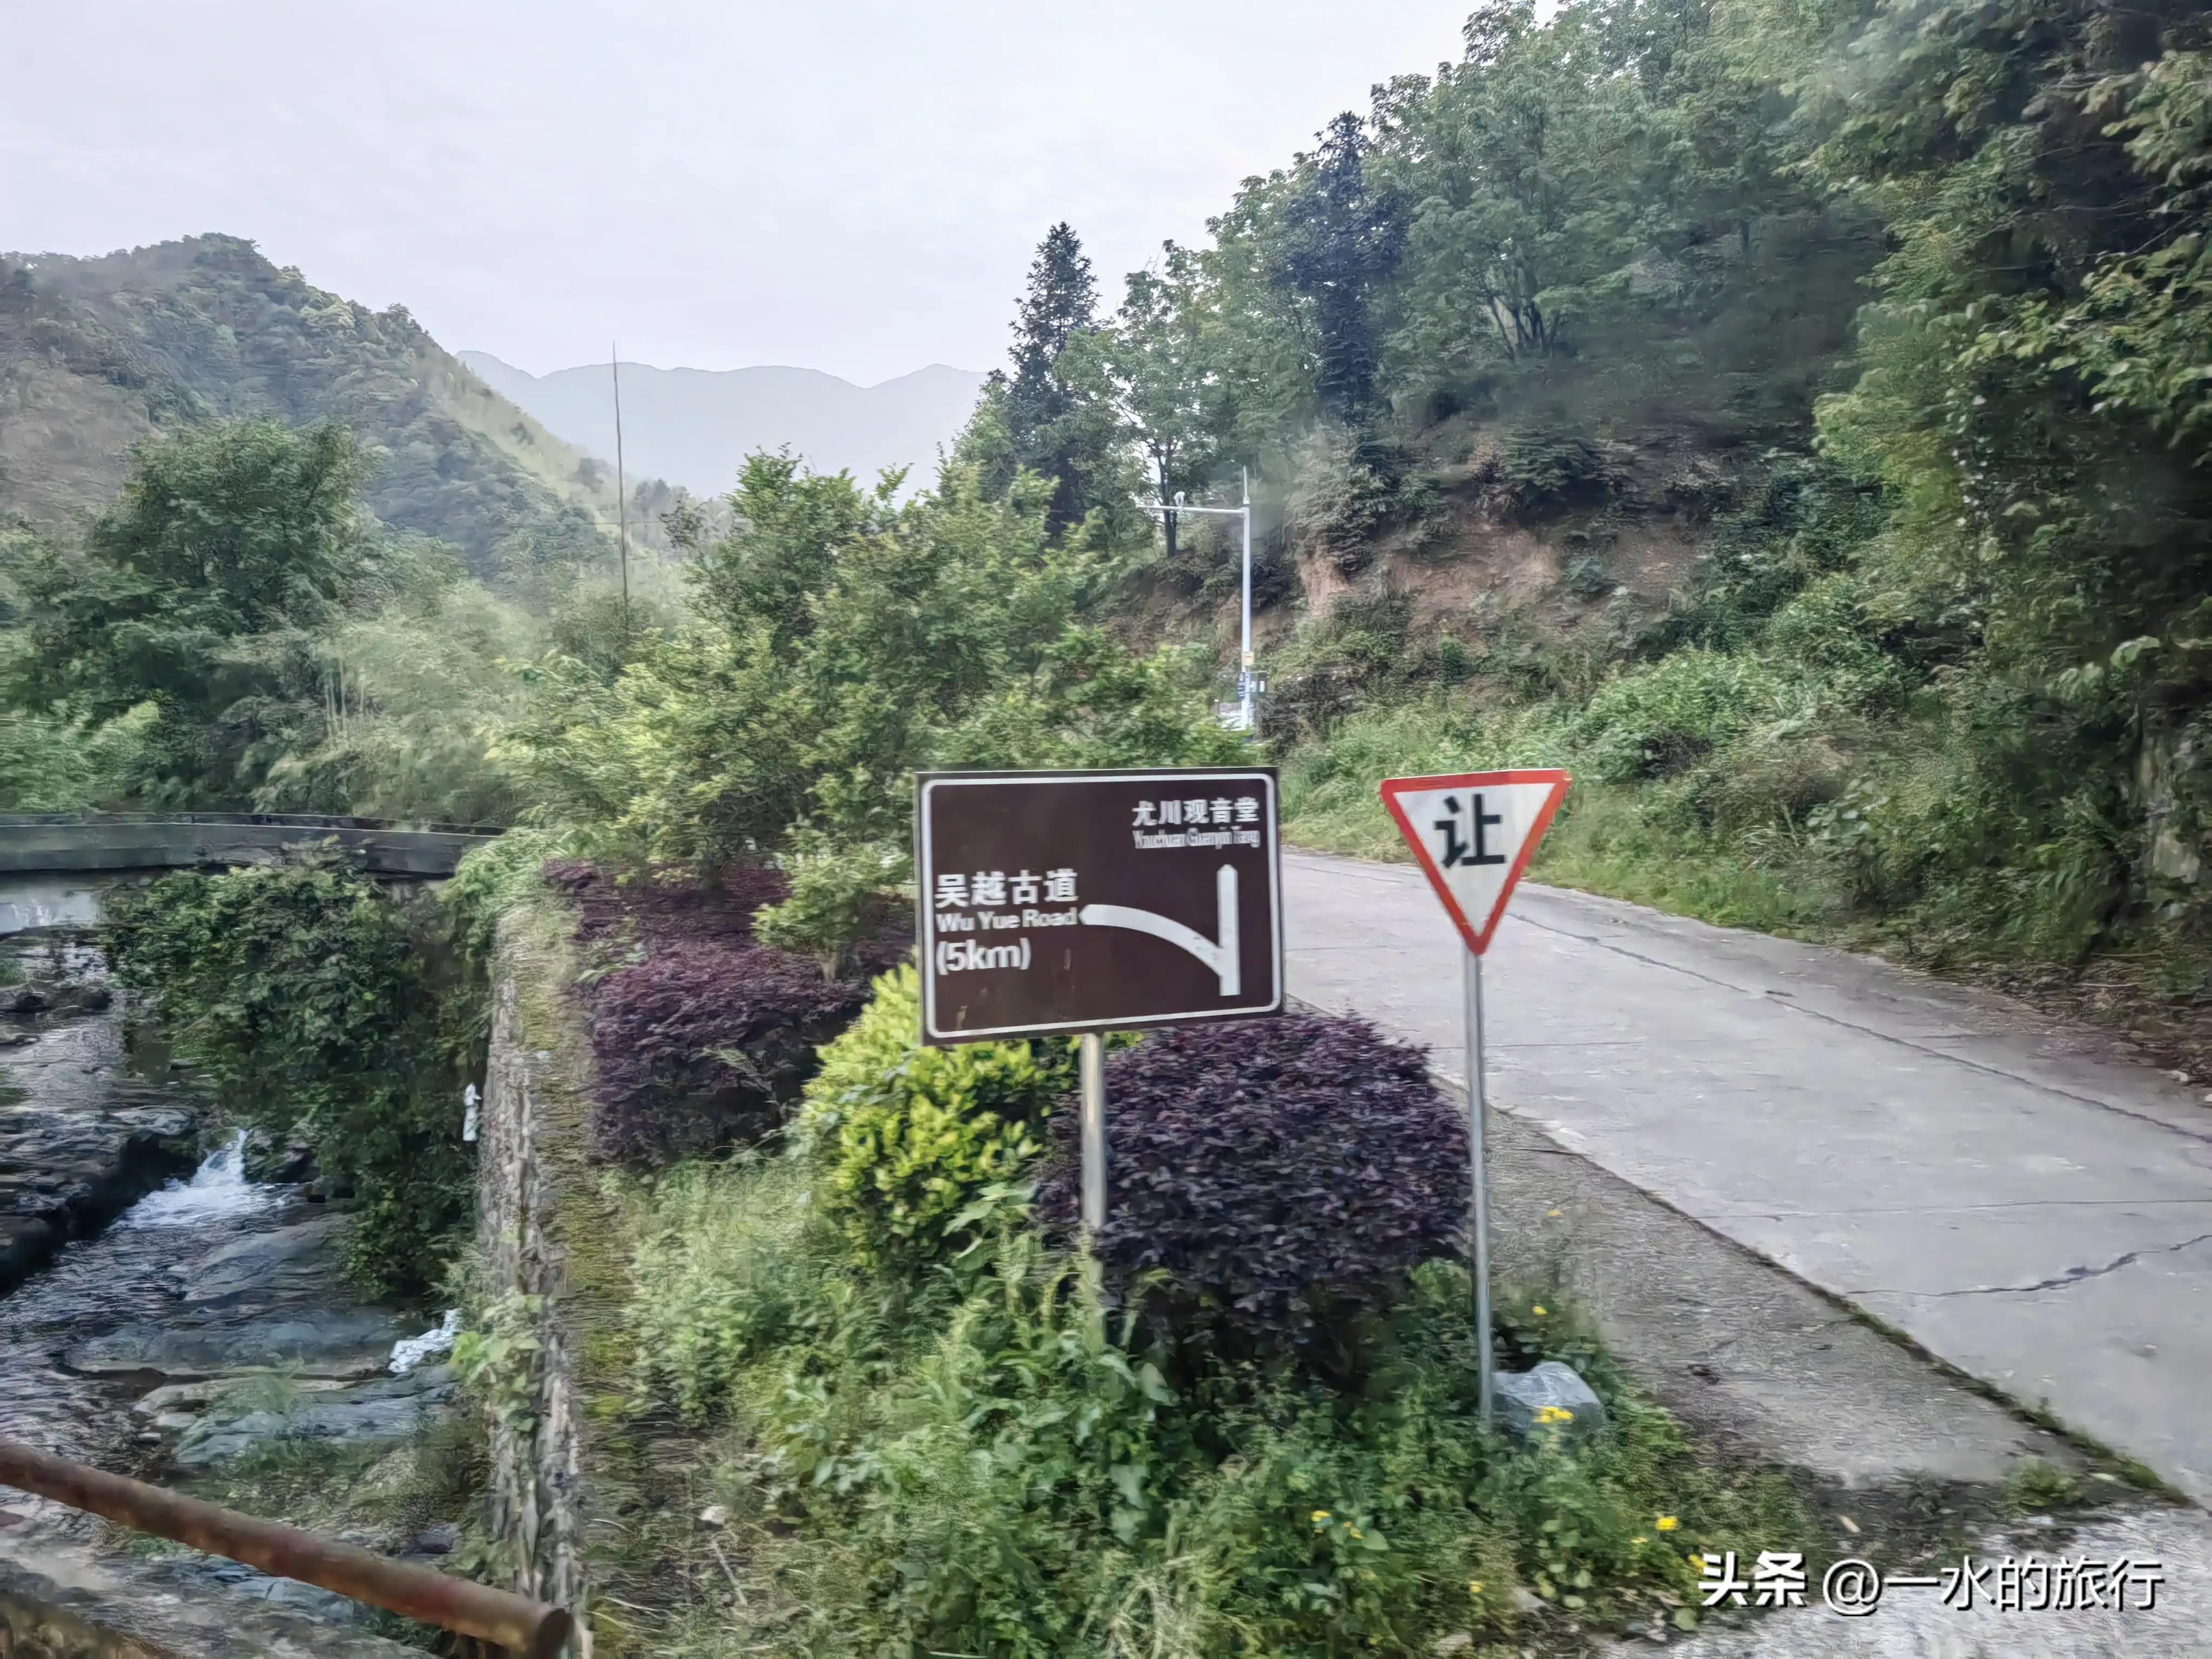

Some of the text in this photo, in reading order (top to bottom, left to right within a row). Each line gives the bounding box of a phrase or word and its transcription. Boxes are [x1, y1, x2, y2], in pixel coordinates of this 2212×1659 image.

[1434, 793, 1506, 869] 让
[934, 868, 1079, 908] 吴越古道
[935, 907, 1077, 932] Wu Yue Road
[936, 938, 1031, 975] (5km)
